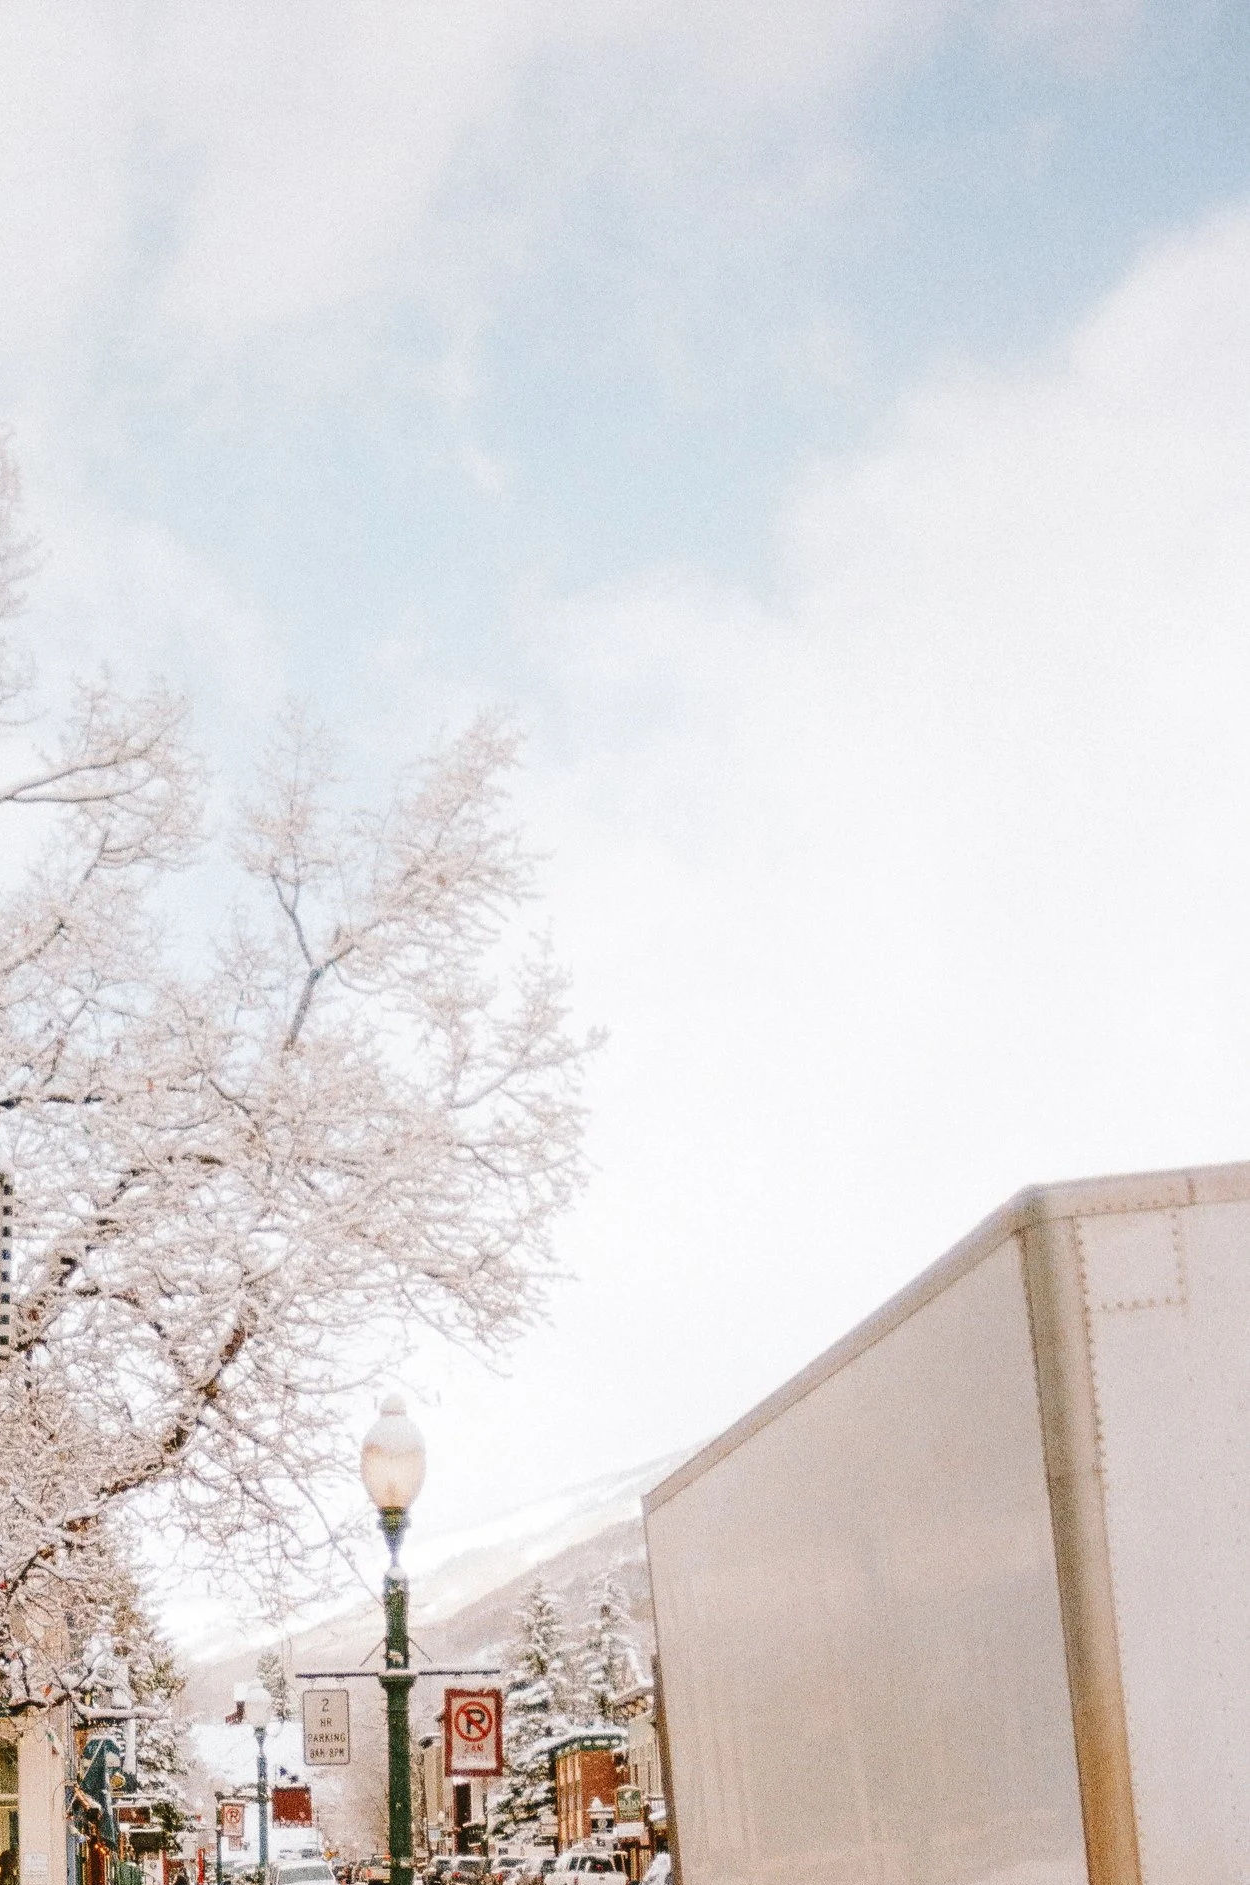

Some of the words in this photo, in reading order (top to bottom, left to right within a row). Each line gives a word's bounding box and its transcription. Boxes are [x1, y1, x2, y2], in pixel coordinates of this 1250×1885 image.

[321, 1697, 330, 1713] 2
[319, 1717, 333, 1727] HR
[307, 1733, 347, 1743] PARKING
